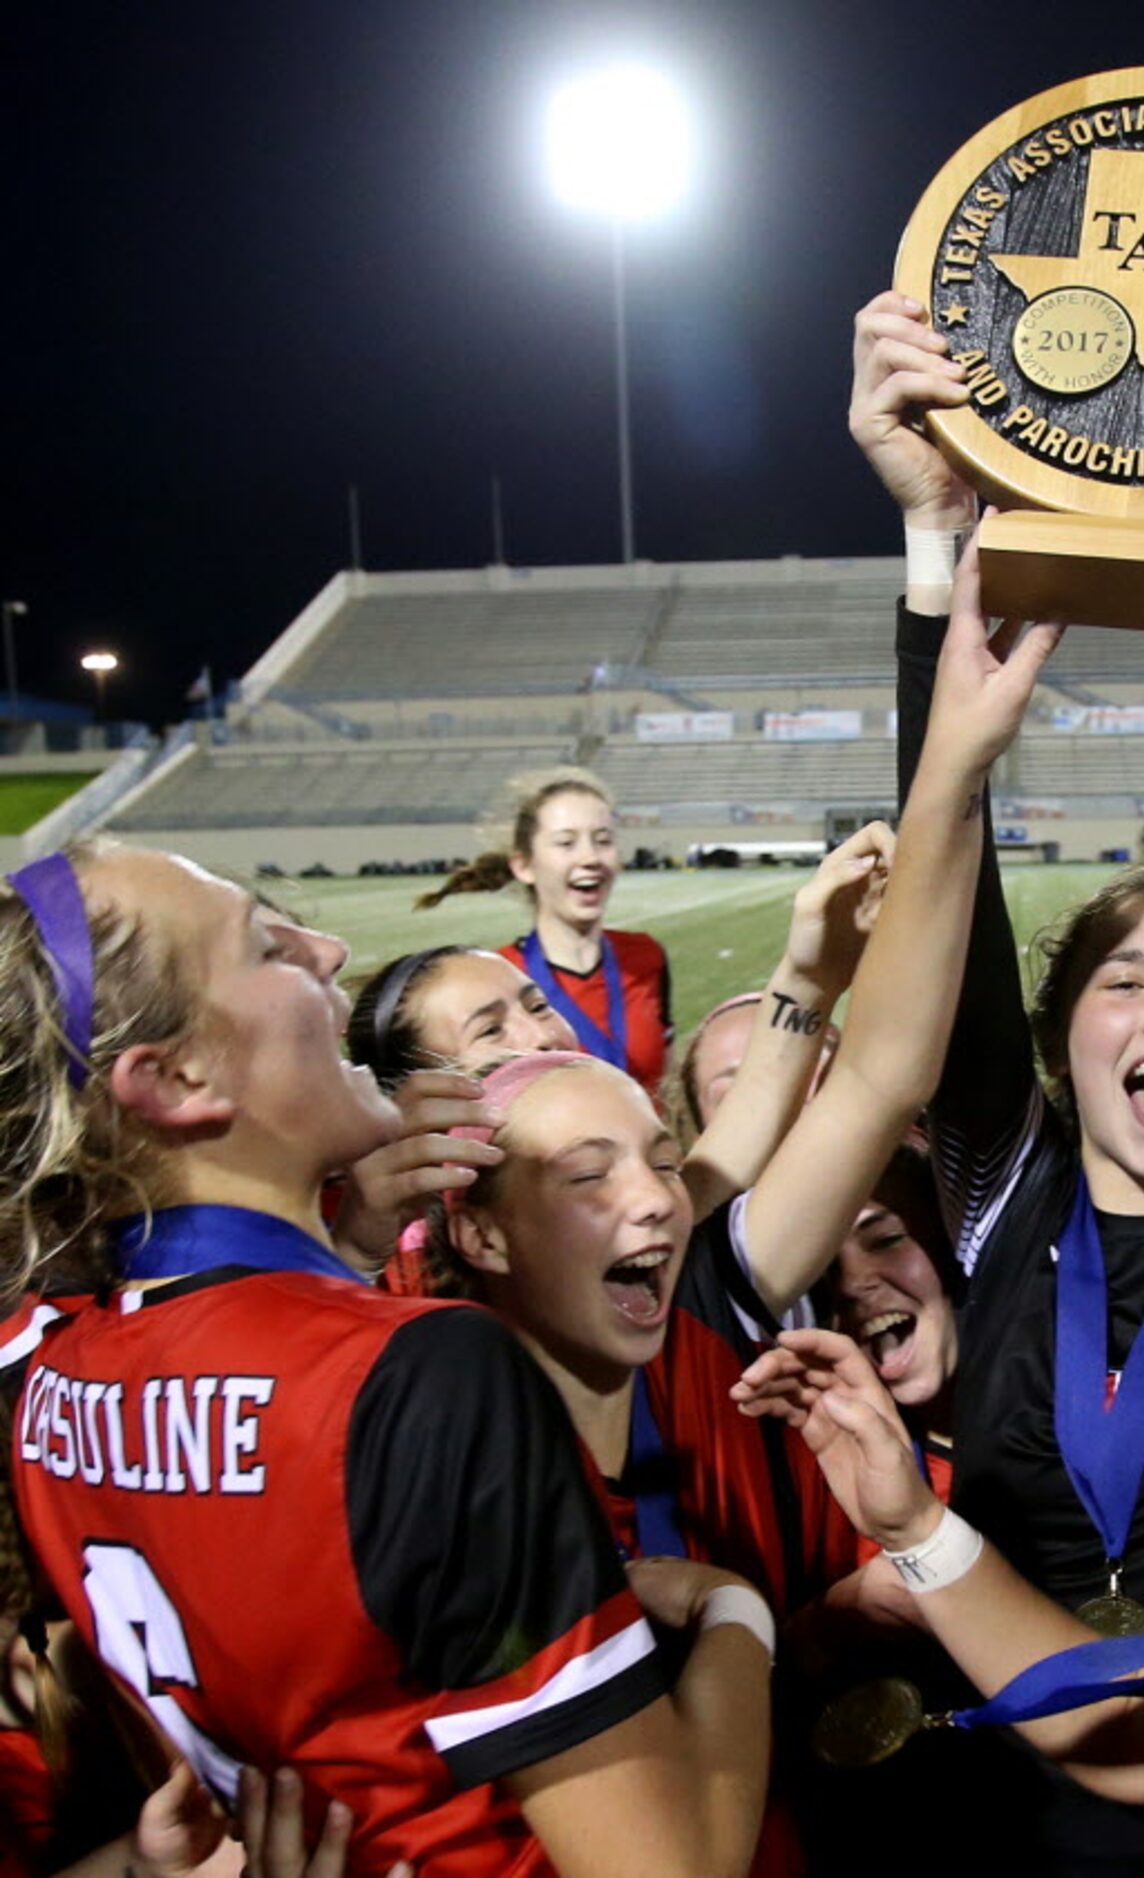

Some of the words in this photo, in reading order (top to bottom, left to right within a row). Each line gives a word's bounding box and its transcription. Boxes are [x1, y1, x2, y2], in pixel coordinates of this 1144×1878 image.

[940, 186, 1007, 284] TEXAS
[1023, 293, 1126, 333] COMPETITION
[1038, 329, 1109, 354] 2017
[952, 348, 1009, 407] AND
[1020, 349, 1056, 386] WITH
[1064, 352, 1121, 389] HONOR
